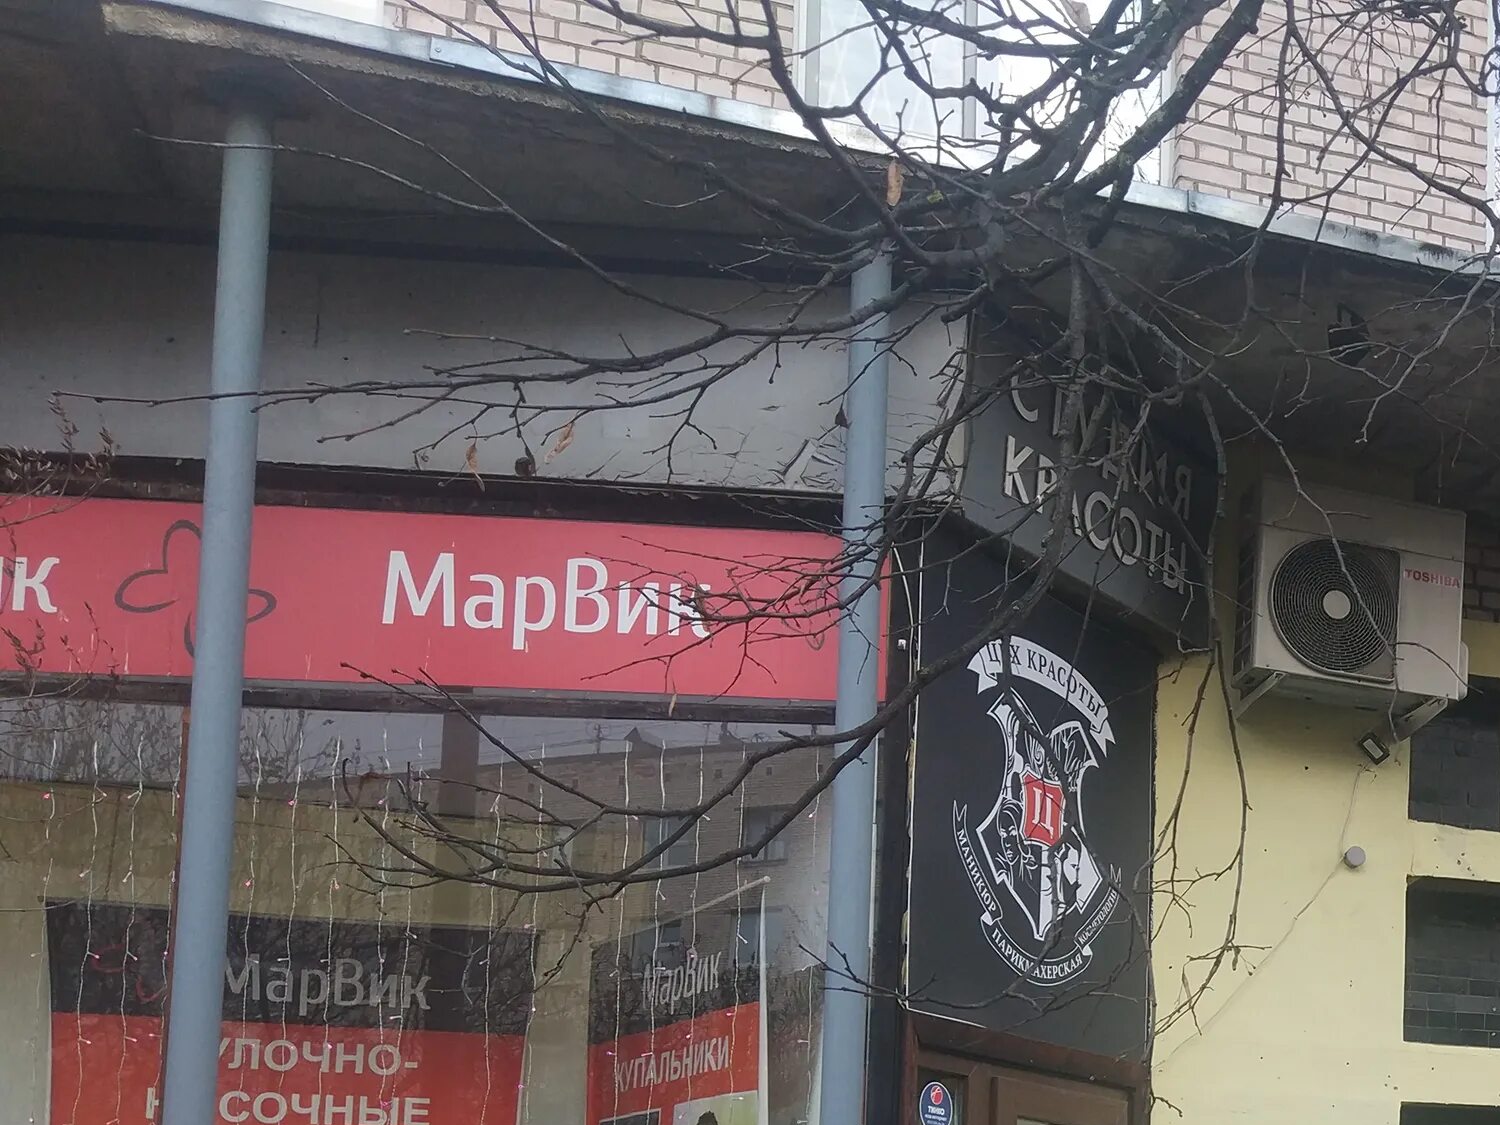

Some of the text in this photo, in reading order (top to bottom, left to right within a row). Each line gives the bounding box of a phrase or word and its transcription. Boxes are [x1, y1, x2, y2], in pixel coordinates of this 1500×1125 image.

[381, 550, 713, 650] МарВик
[1404, 568, 1460, 588] TOSHIBA
[986, 642, 1102, 718] ЦХ КРАСОТЫ
[956, 828, 997, 913] МАНИКЮР
[219, 1037, 418, 1076] ЛОЧНО-
[614, 1035, 730, 1093] КУПАЛЬНИКИ
